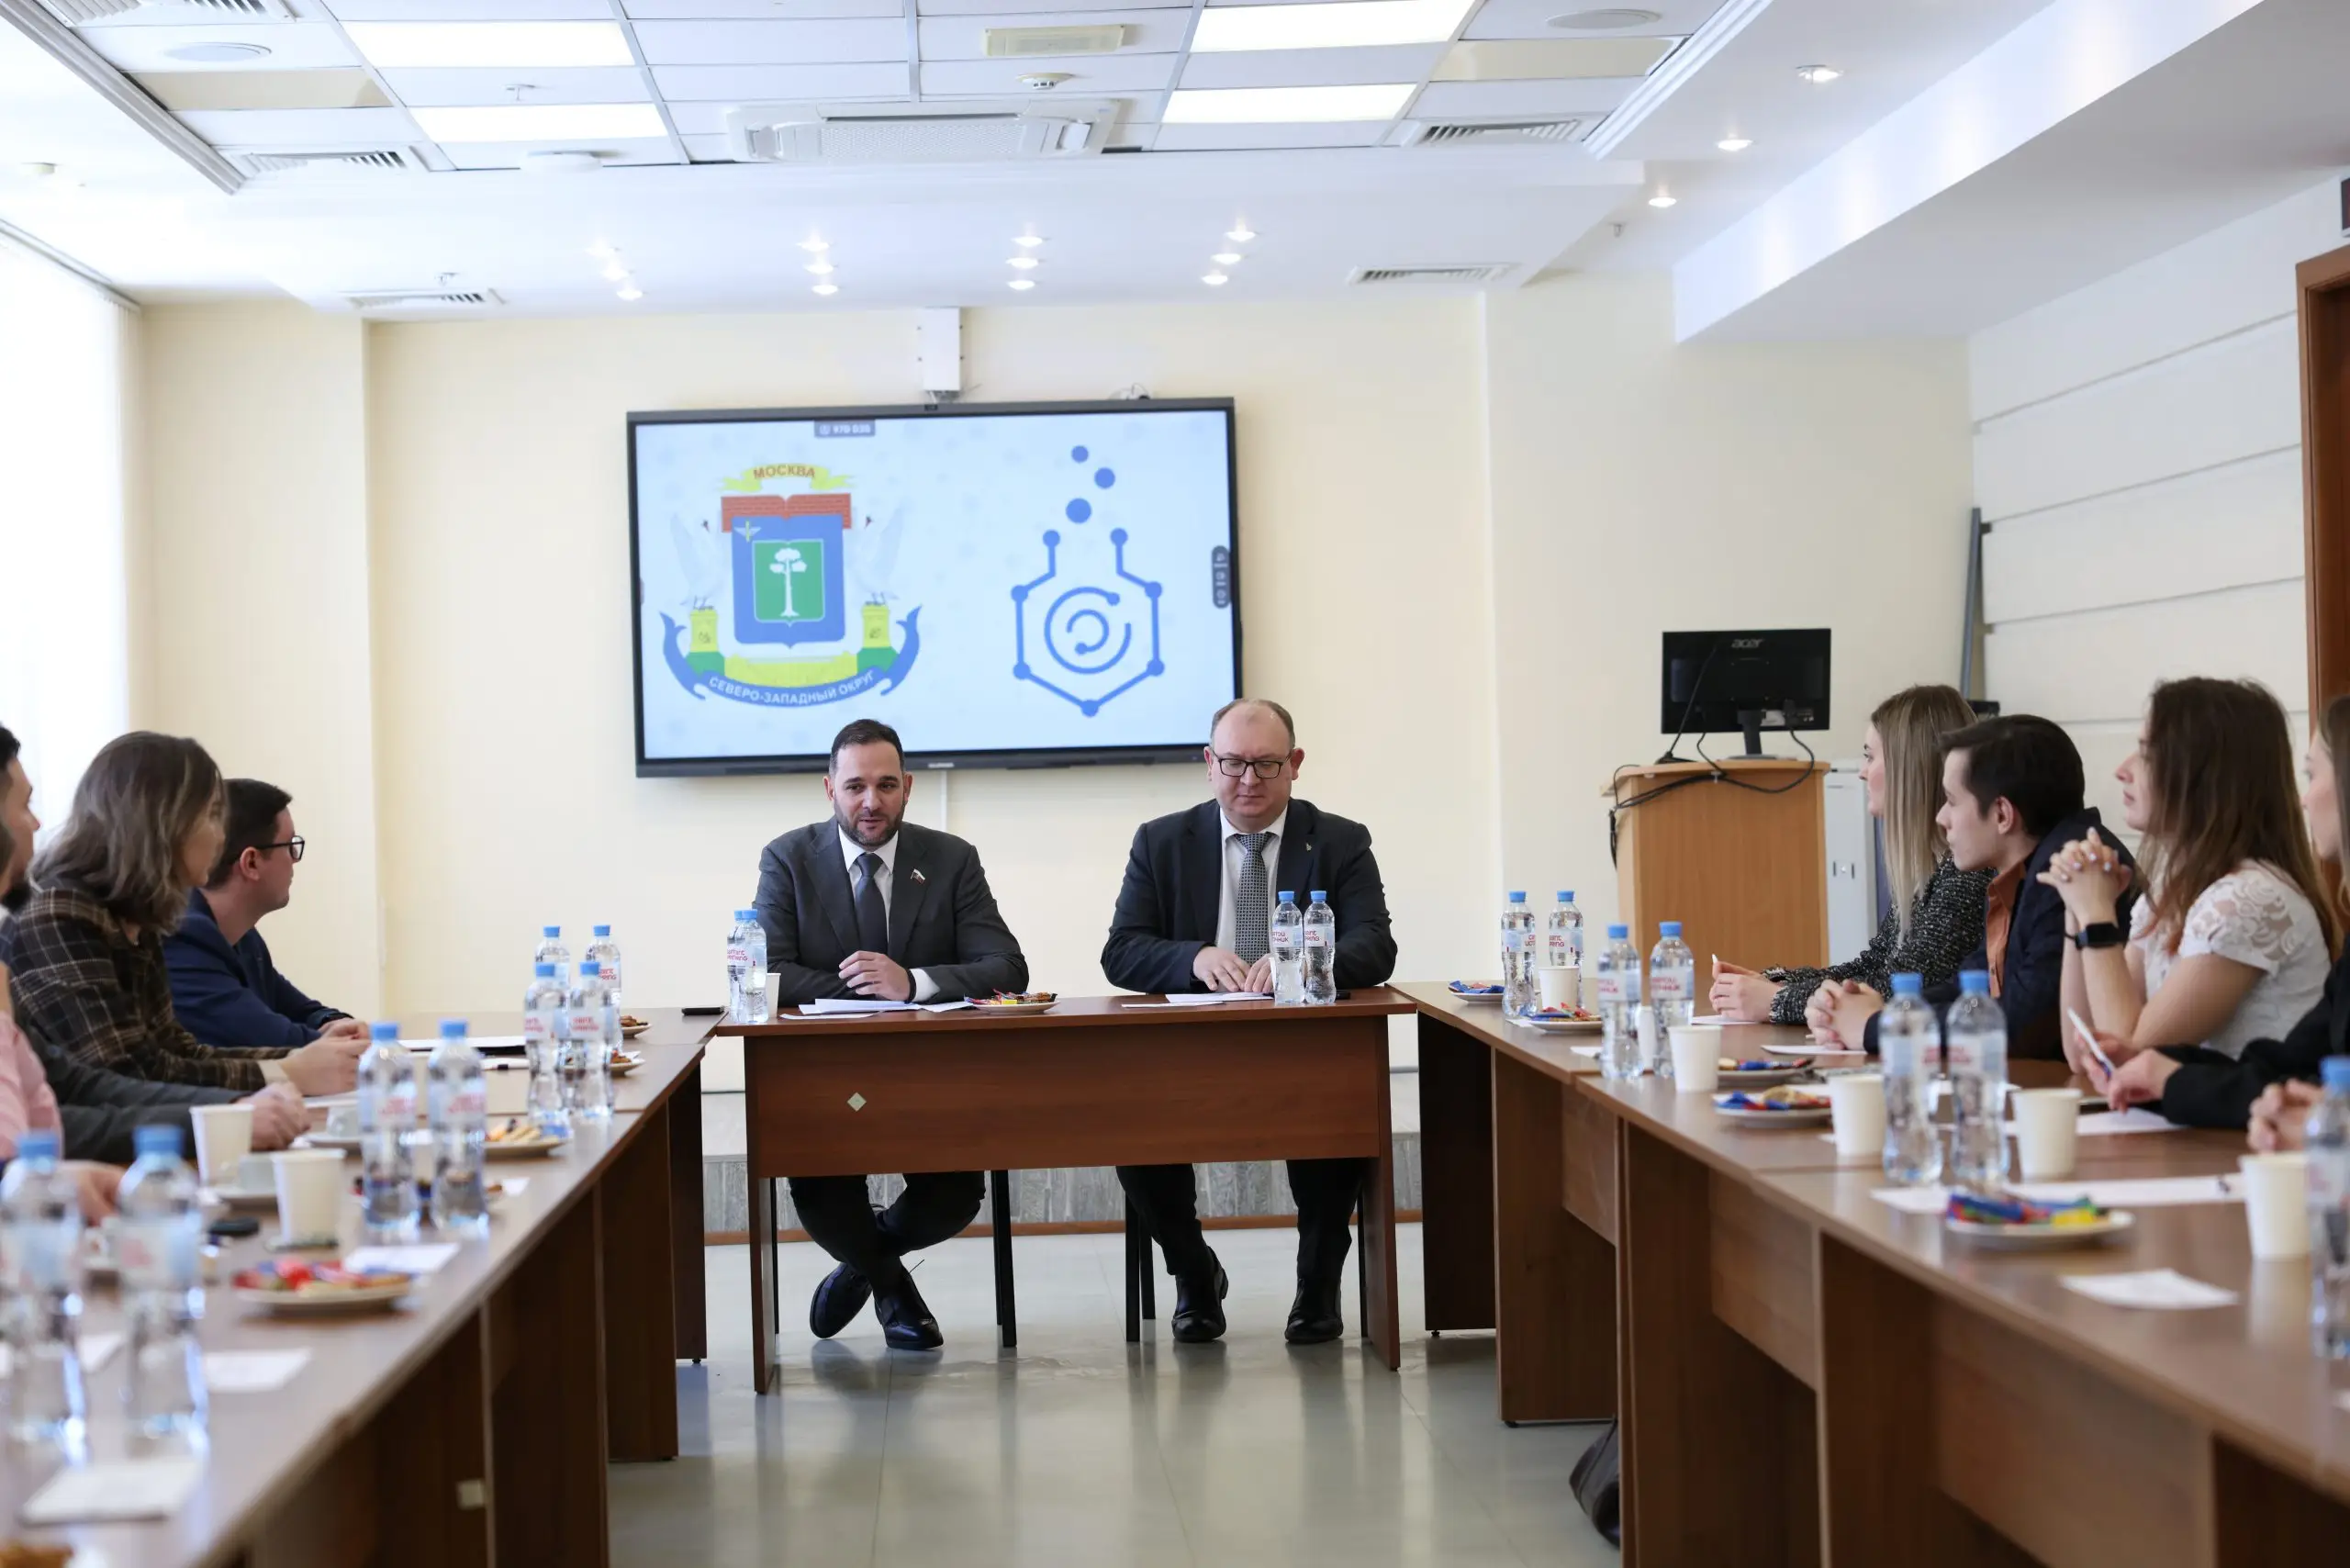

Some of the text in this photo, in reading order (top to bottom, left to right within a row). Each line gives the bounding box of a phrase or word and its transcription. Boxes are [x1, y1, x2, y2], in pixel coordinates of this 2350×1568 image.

[753, 465, 815, 479] МОСКВА
[1731, 638, 1764, 648] acer
[709, 669, 873, 705] СЕВЕРО-ЗАПАДНЫЙ ОКРУГ
